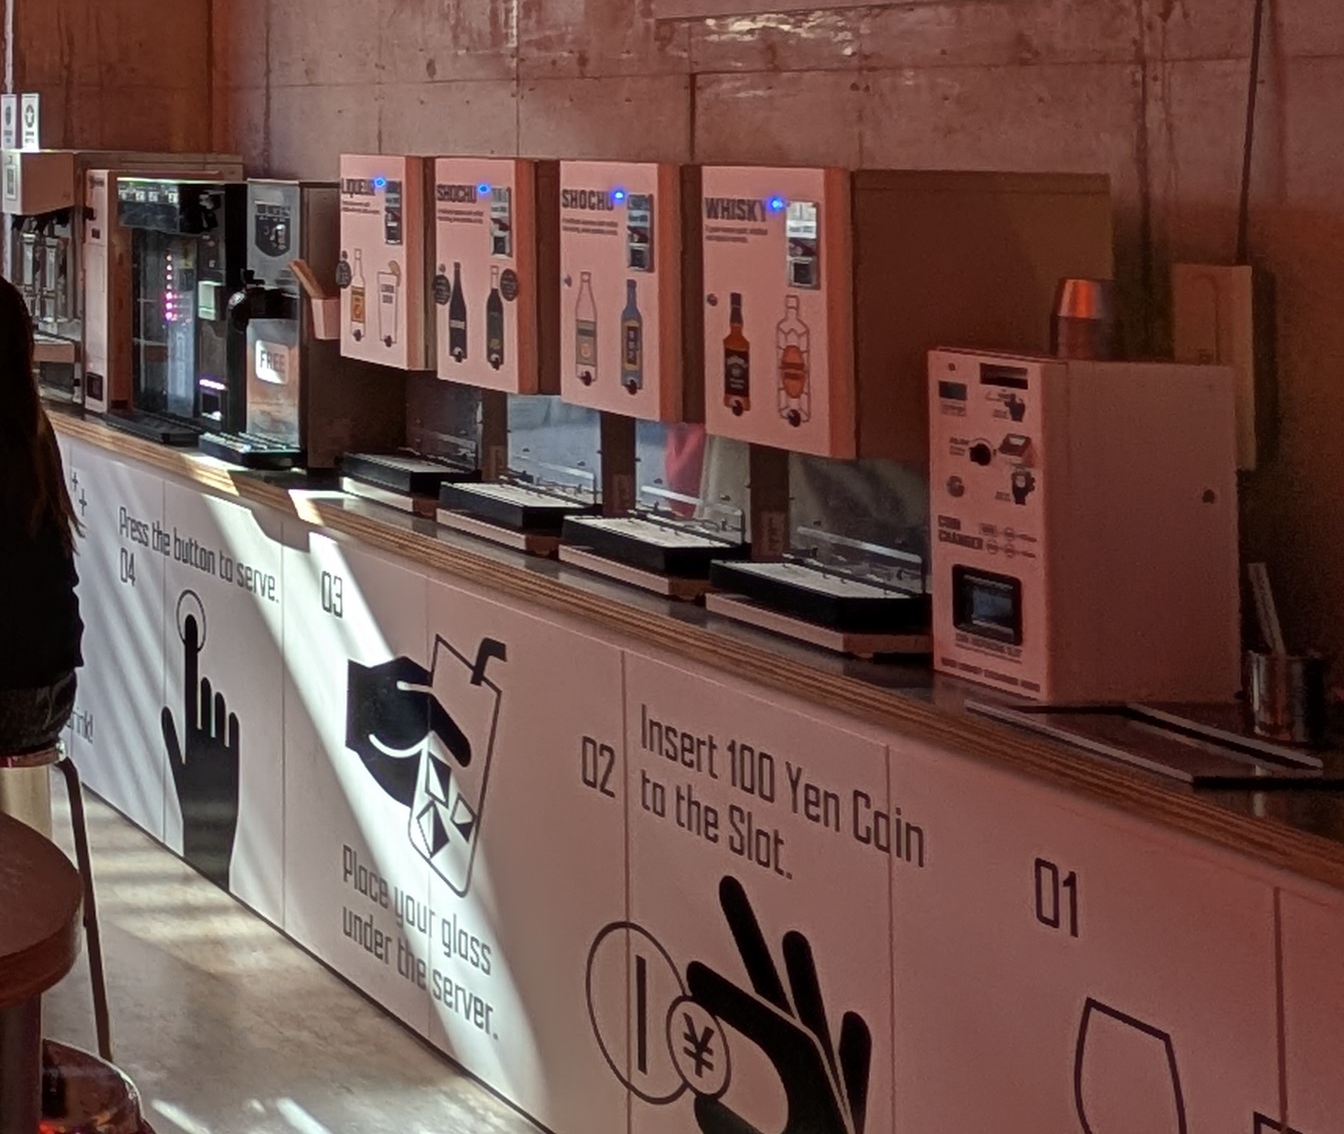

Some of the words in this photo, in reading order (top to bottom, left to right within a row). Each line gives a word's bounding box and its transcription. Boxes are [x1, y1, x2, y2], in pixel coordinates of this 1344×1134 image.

[437, 184, 477, 204] SHOCHU
[562, 189, 615, 211] SHOCHU
[704, 197, 767, 223] WHISKY
[259, 349, 287, 375] FREE
[119, 506, 150, 547] Press
[152, 521, 170, 556] the
[174, 527, 215, 576] button
[219, 550, 233, 583] to
[237, 562, 280, 604] serve.
[120, 548, 136, 587] 04
[321, 571, 343, 618] 03
[581, 736, 616, 798] 02
[641, 703, 718, 779] Insert
[727, 739, 776, 803] 100
[785, 761, 841, 832] Yen
[853, 789, 924, 867] Coin
[641, 769, 666, 818] to
[676, 784, 719, 844] the
[728, 804, 793, 880] Slot.
[343, 844, 389, 909] Place
[394, 886, 436, 939] your
[442, 913, 492, 976] glass
[1034, 857, 1079, 938] 01
[343, 906, 392, 965] under
[397, 936, 427, 991] the
[432, 968, 499, 1041] server.
